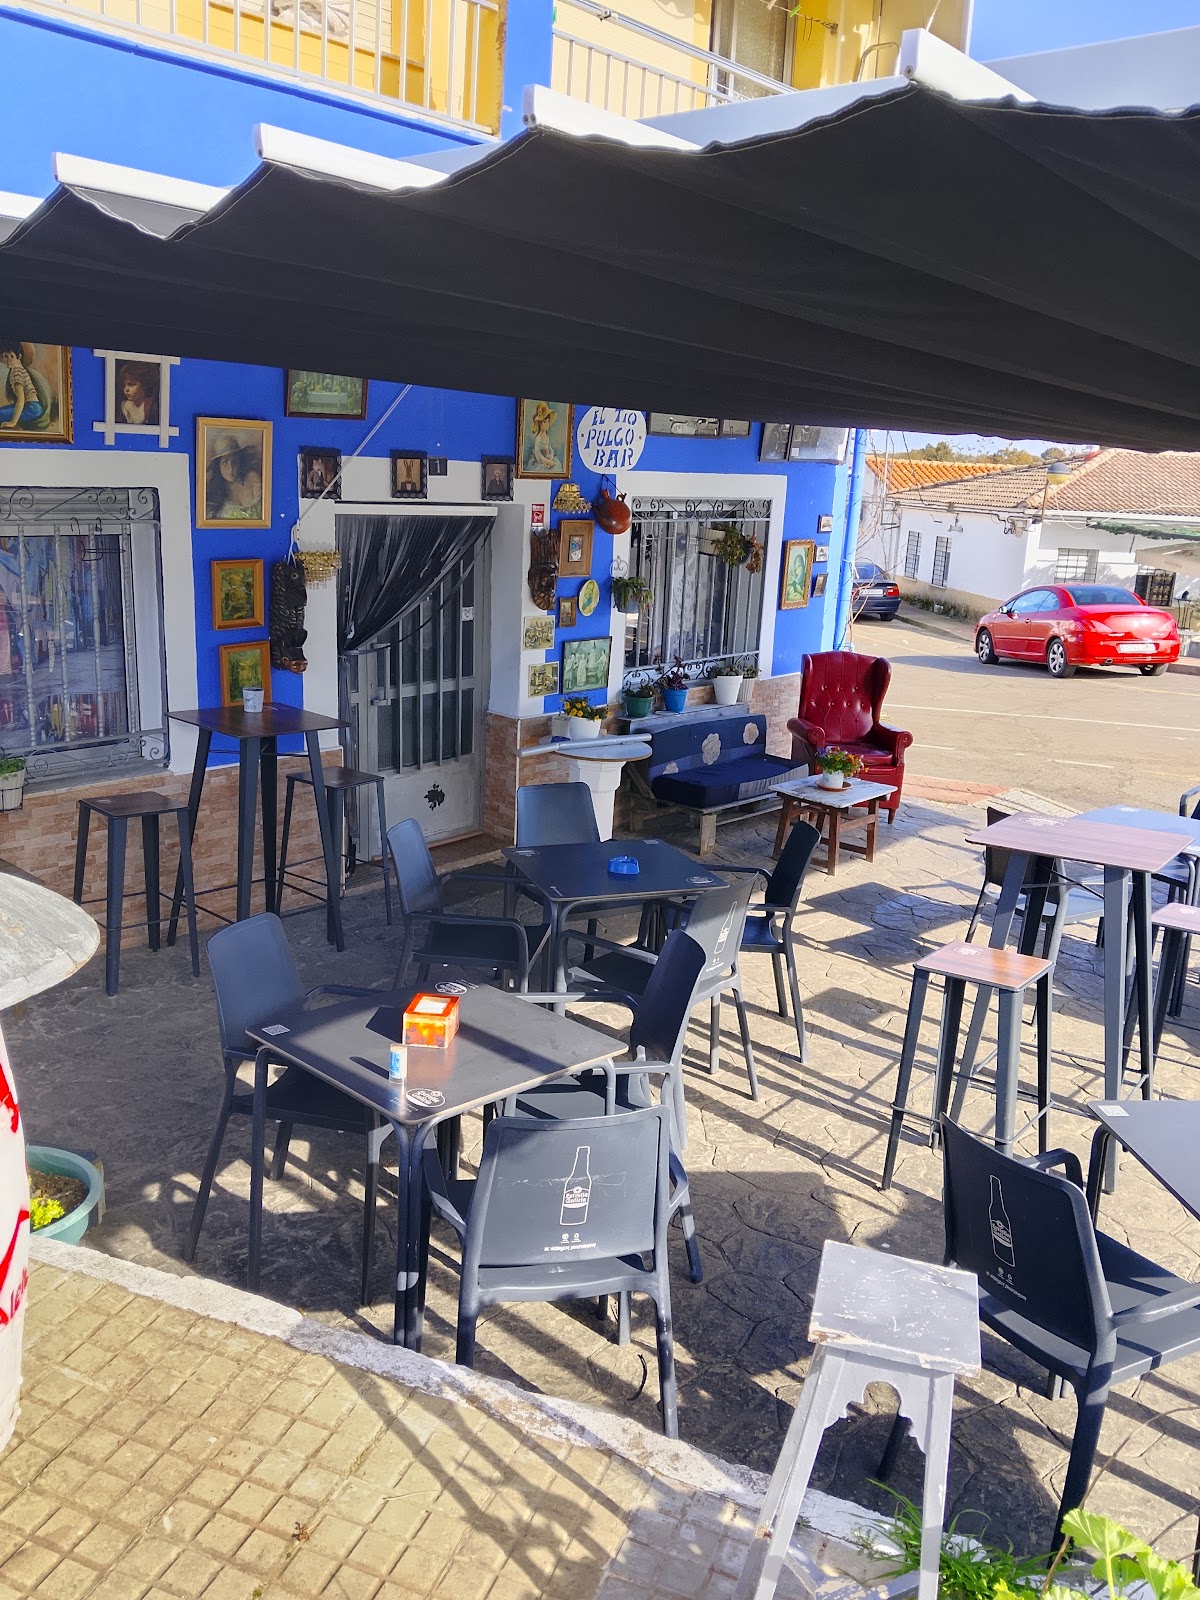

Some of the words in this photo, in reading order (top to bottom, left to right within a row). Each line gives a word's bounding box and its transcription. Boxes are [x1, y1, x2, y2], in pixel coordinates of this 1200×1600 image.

[591, 407, 605, 426] EL
[584, 427, 635, 450] PULGO
[593, 448, 634, 468] BAR
